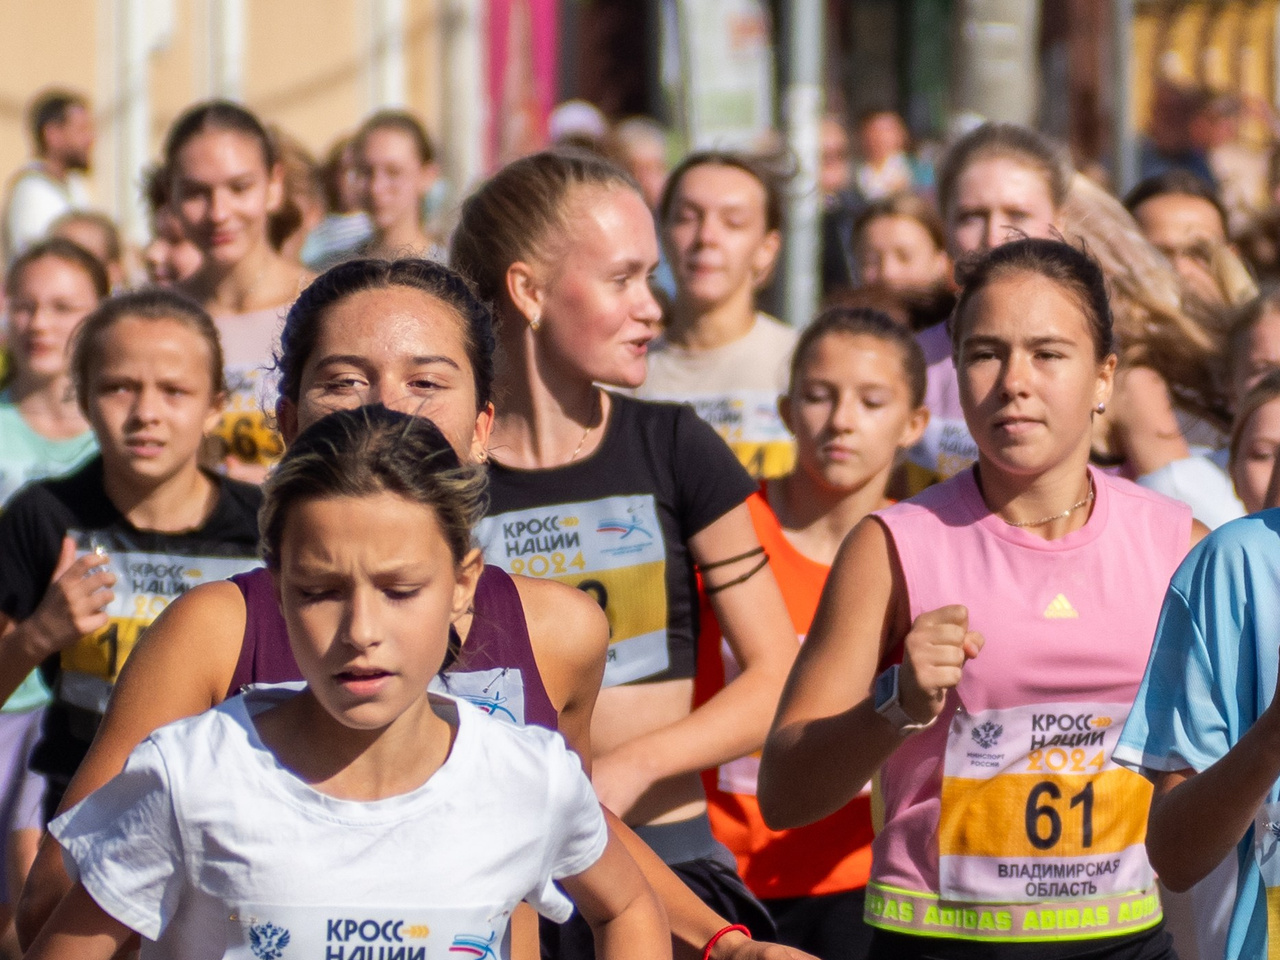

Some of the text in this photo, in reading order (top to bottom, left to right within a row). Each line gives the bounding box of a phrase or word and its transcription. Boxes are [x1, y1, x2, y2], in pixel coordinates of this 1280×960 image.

[503, 515, 560, 540] КРОСС
[506, 532, 580, 557] НАЦИИ
[511, 550, 586, 576] 2024
[133, 579, 192, 594] НАЦИ
[1032, 714, 1093, 731] КРОСС
[1031, 731, 1105, 751] НАЦИИ
[1026, 748, 1105, 772] 2024
[1024, 781, 1095, 850] 61
[997, 858, 1121, 879] ВЛАДИМИРСКАЯ
[1025, 880, 1098, 898] ОБЛАСТЬ
[922, 905, 1012, 931] ADIDAS
[1022, 905, 1110, 931] ADIDAS
[327, 919, 404, 942] КРОСС
